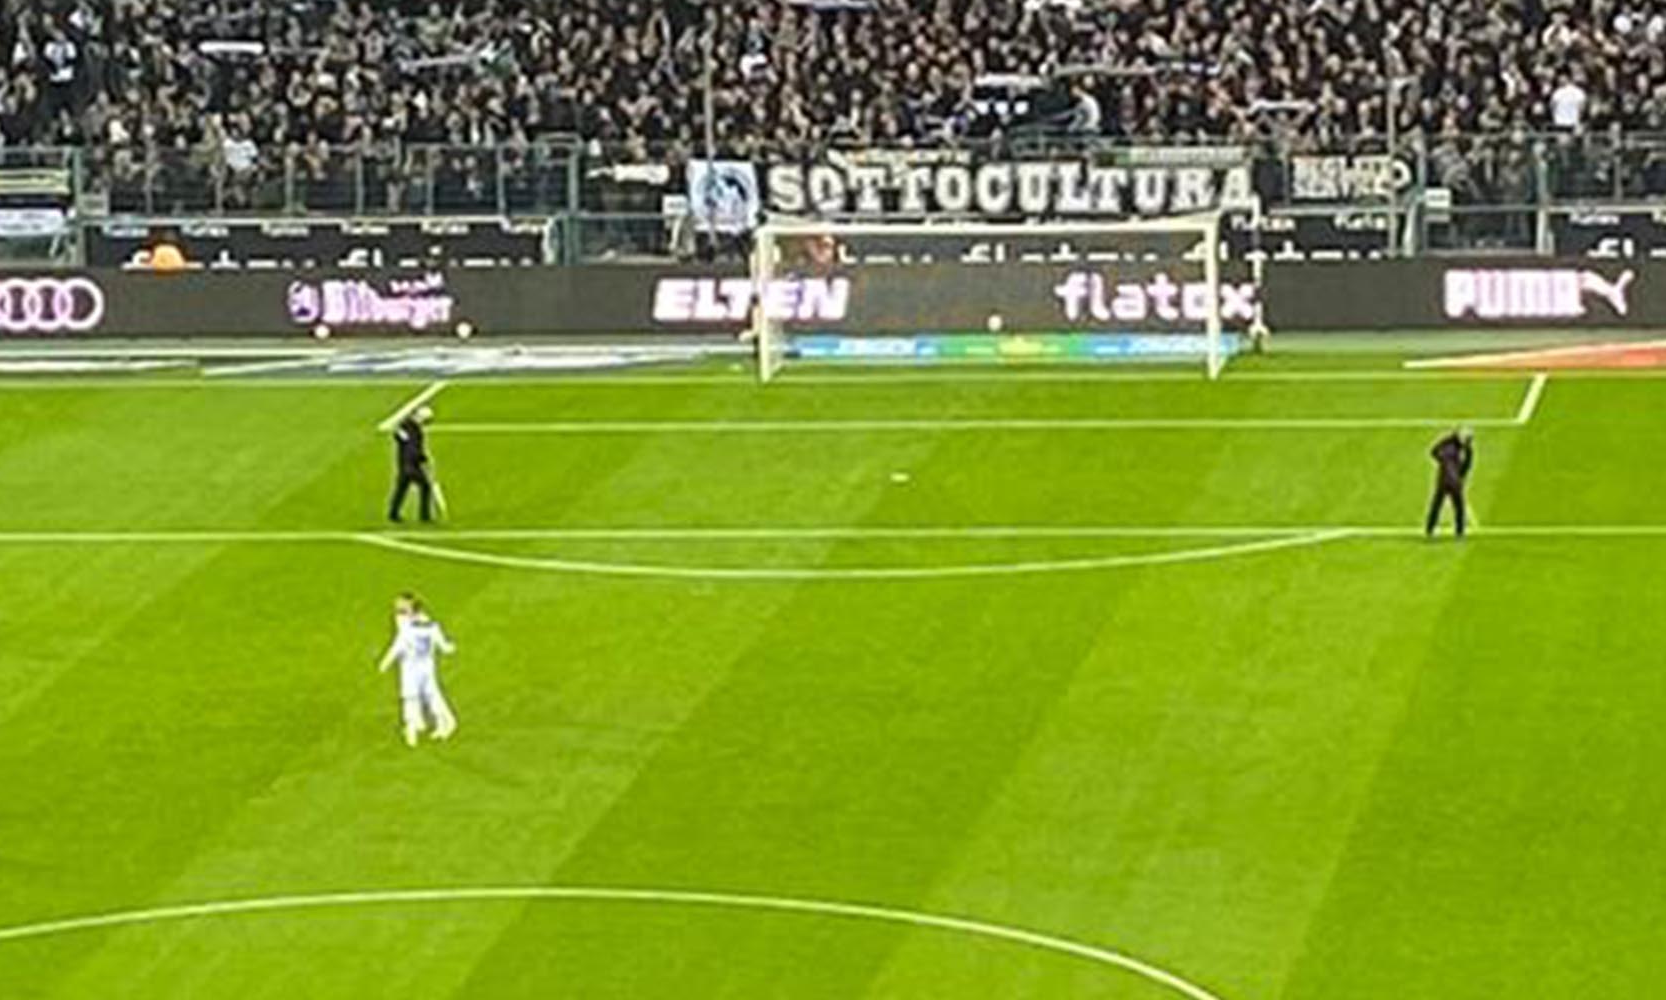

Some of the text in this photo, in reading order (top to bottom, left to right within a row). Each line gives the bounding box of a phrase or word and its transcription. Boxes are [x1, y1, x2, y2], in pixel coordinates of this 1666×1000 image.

[767, 162, 1253, 214] SOTTOCULTURA
[652, 278, 850, 321] ELTEN
[1053, 272, 1255, 321] flatex
[1445, 269, 1586, 317] PUMA
